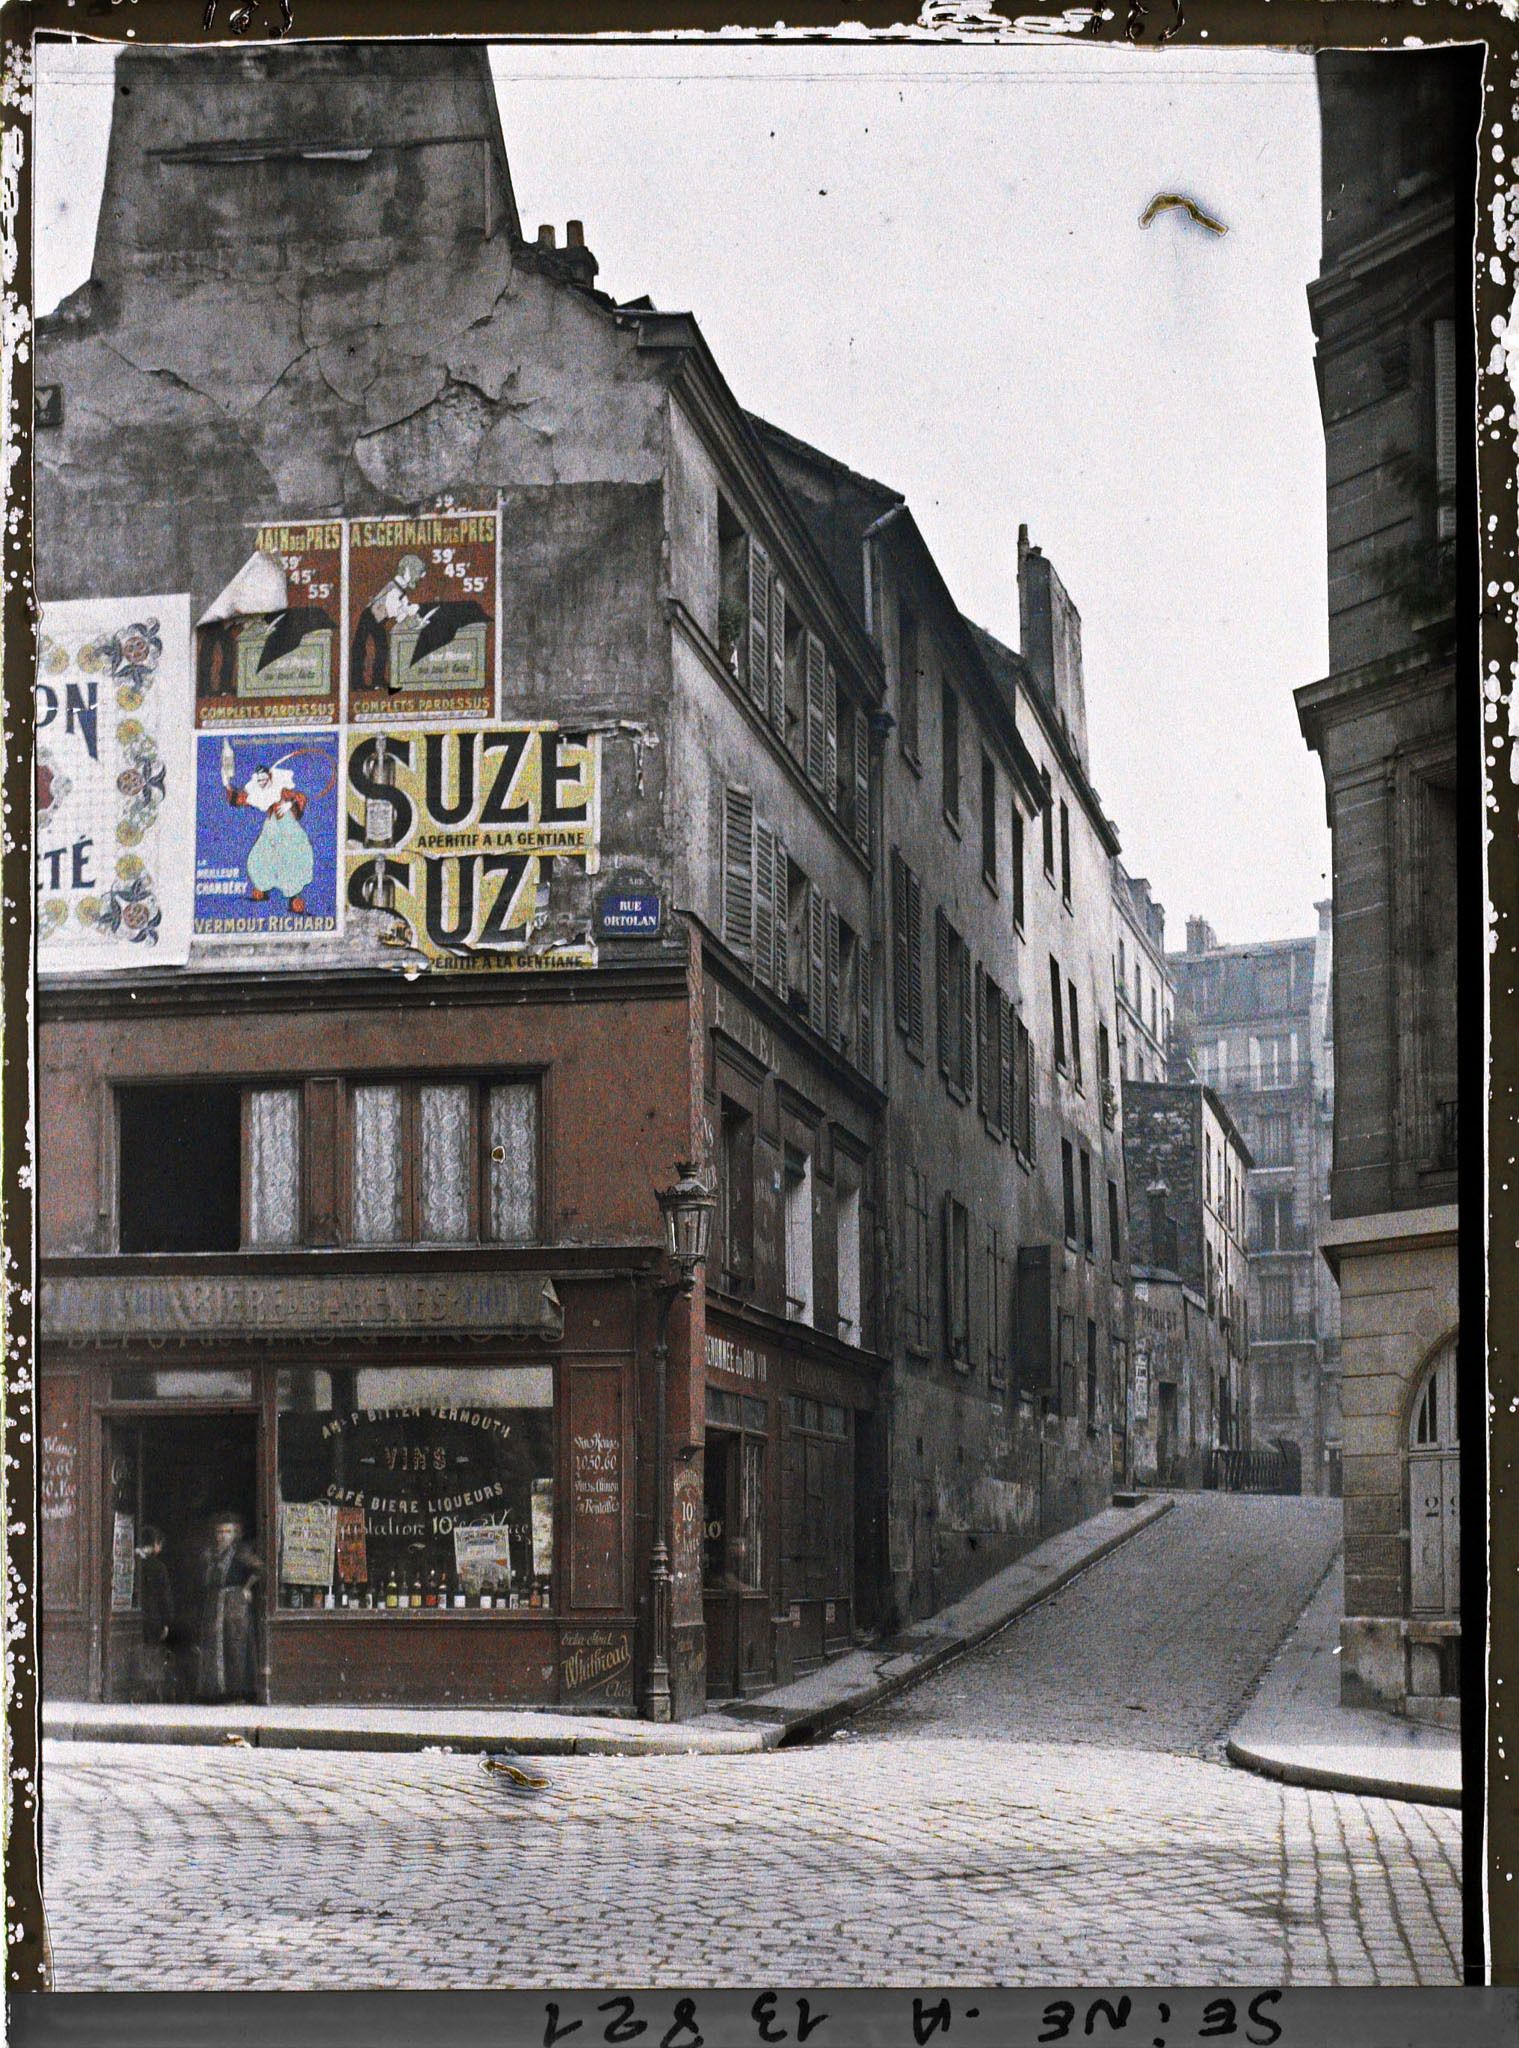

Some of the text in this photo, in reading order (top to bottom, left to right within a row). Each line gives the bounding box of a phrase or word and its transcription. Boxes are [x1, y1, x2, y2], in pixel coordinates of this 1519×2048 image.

[200, 703, 336, 719] COMPLETS PARDESSUS
[353, 697, 491, 713] COMPLETS PARDESSUS
[348, 731, 587, 848] SUZE
[497, 833, 513, 846] LA
[517, 832, 585, 846] GENTIANE
[37, 834, 97, 891] TÉ
[349, 854, 587, 944] SUZ
[619, 900, 642, 912] RUE
[194, 915, 334, 933] VERMOUT RICHARD
[603, 915, 657, 927] ORTOLAN
[517, 954, 584, 969] GENTIANE
[430, 1405, 511, 1439] VERMOUTH
[384, 1447, 447, 1471] VINS
[327, 1484, 364, 1508] CAFÉ
[428, 1482, 504, 1514] LIQUEURS
[560, 1634, 632, 1690] Whitbread
